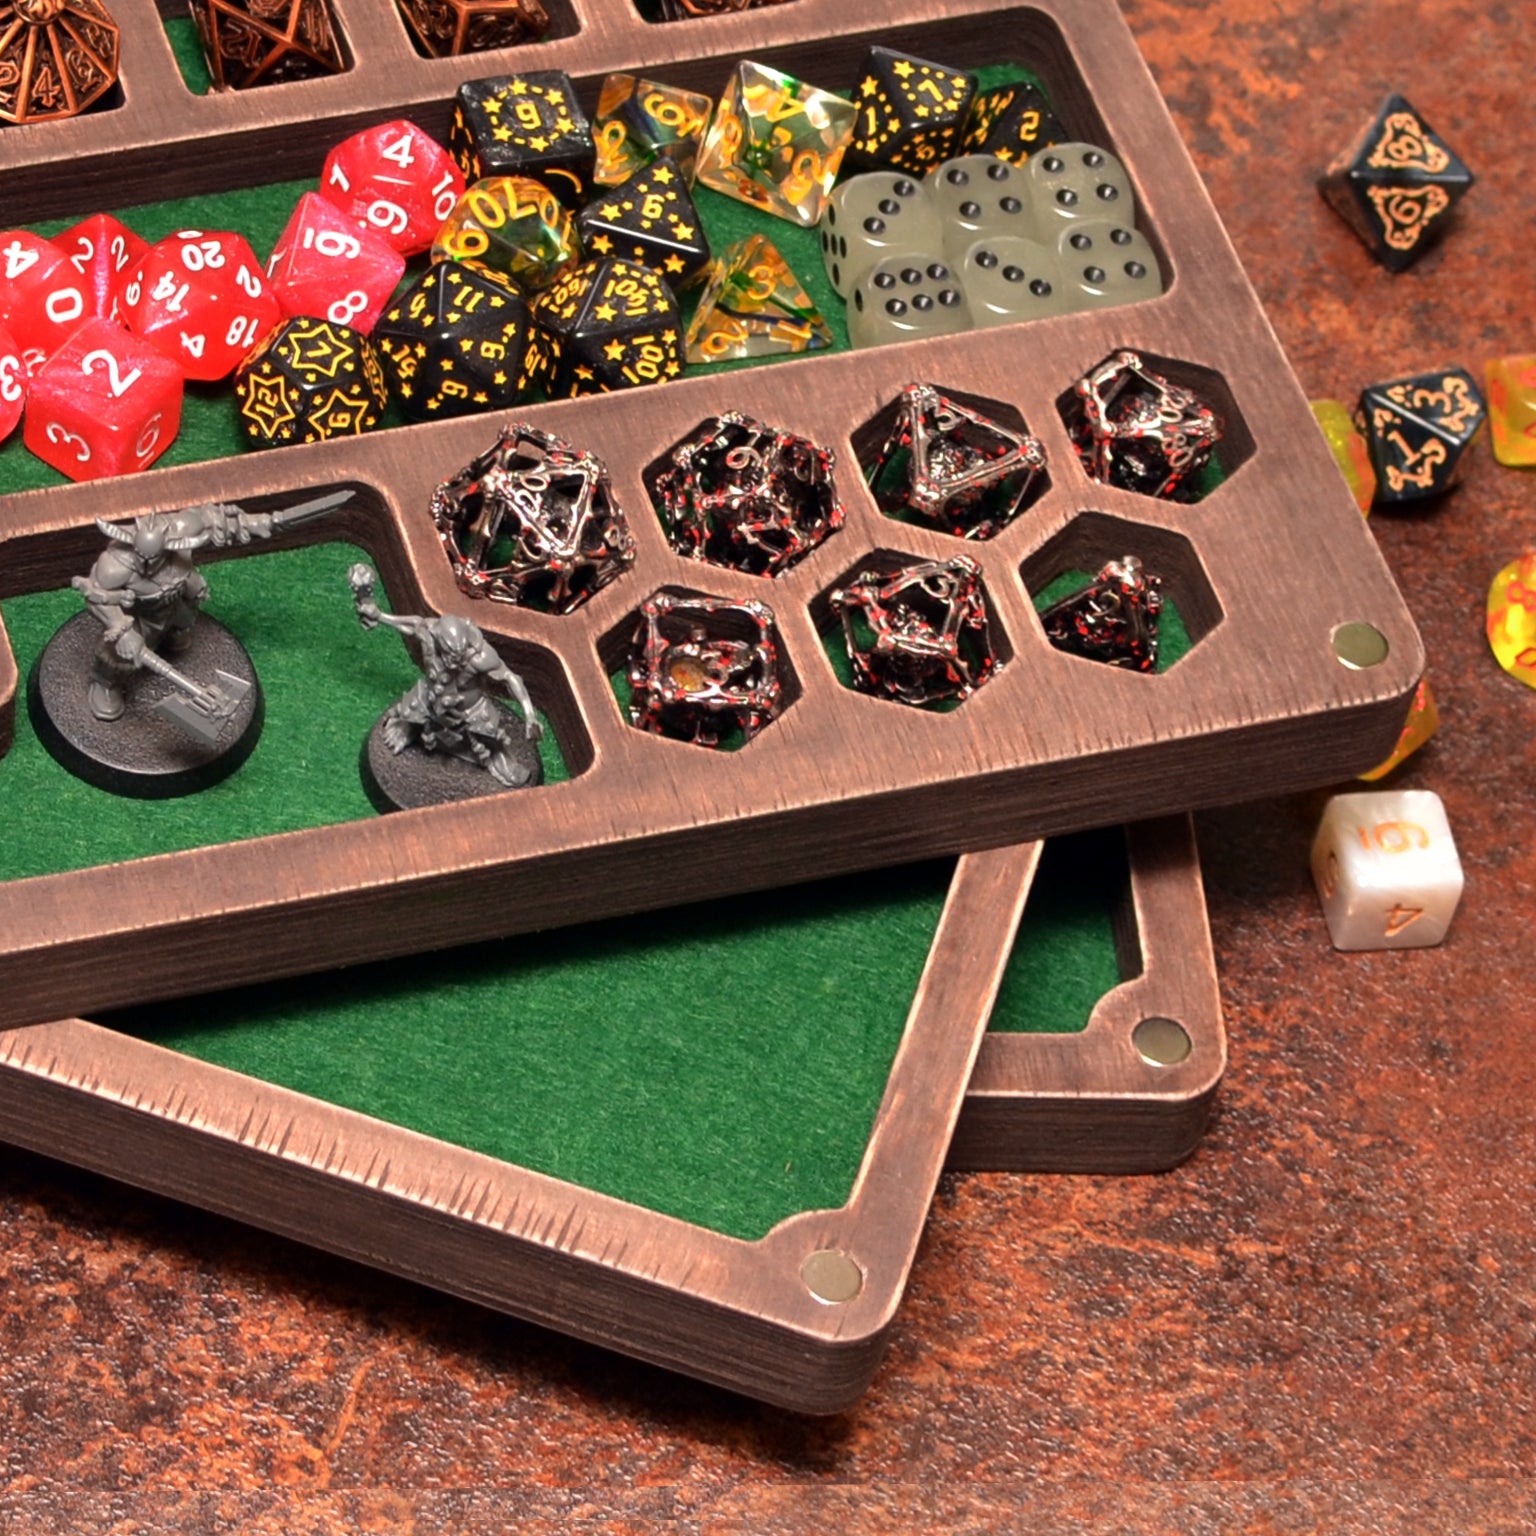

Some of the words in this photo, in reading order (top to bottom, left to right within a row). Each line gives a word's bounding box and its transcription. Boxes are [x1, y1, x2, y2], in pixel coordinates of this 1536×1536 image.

[33, 67, 60, 107] 4
[382, 135, 414, 168] 4
[1388, 134, 1423, 160] 8
[432, 170, 456, 221] 10
[3, 241, 39, 278] 4
[70, 237, 94, 274] 2
[181, 241, 225, 271] 20
[748, 265, 777, 300] 3
[46, 288, 83, 323] 0
[327, 290, 368, 326] 8
[180, 332, 206, 358] 4
[82, 350, 142, 398] 2
[46, 422, 91, 462] 3
